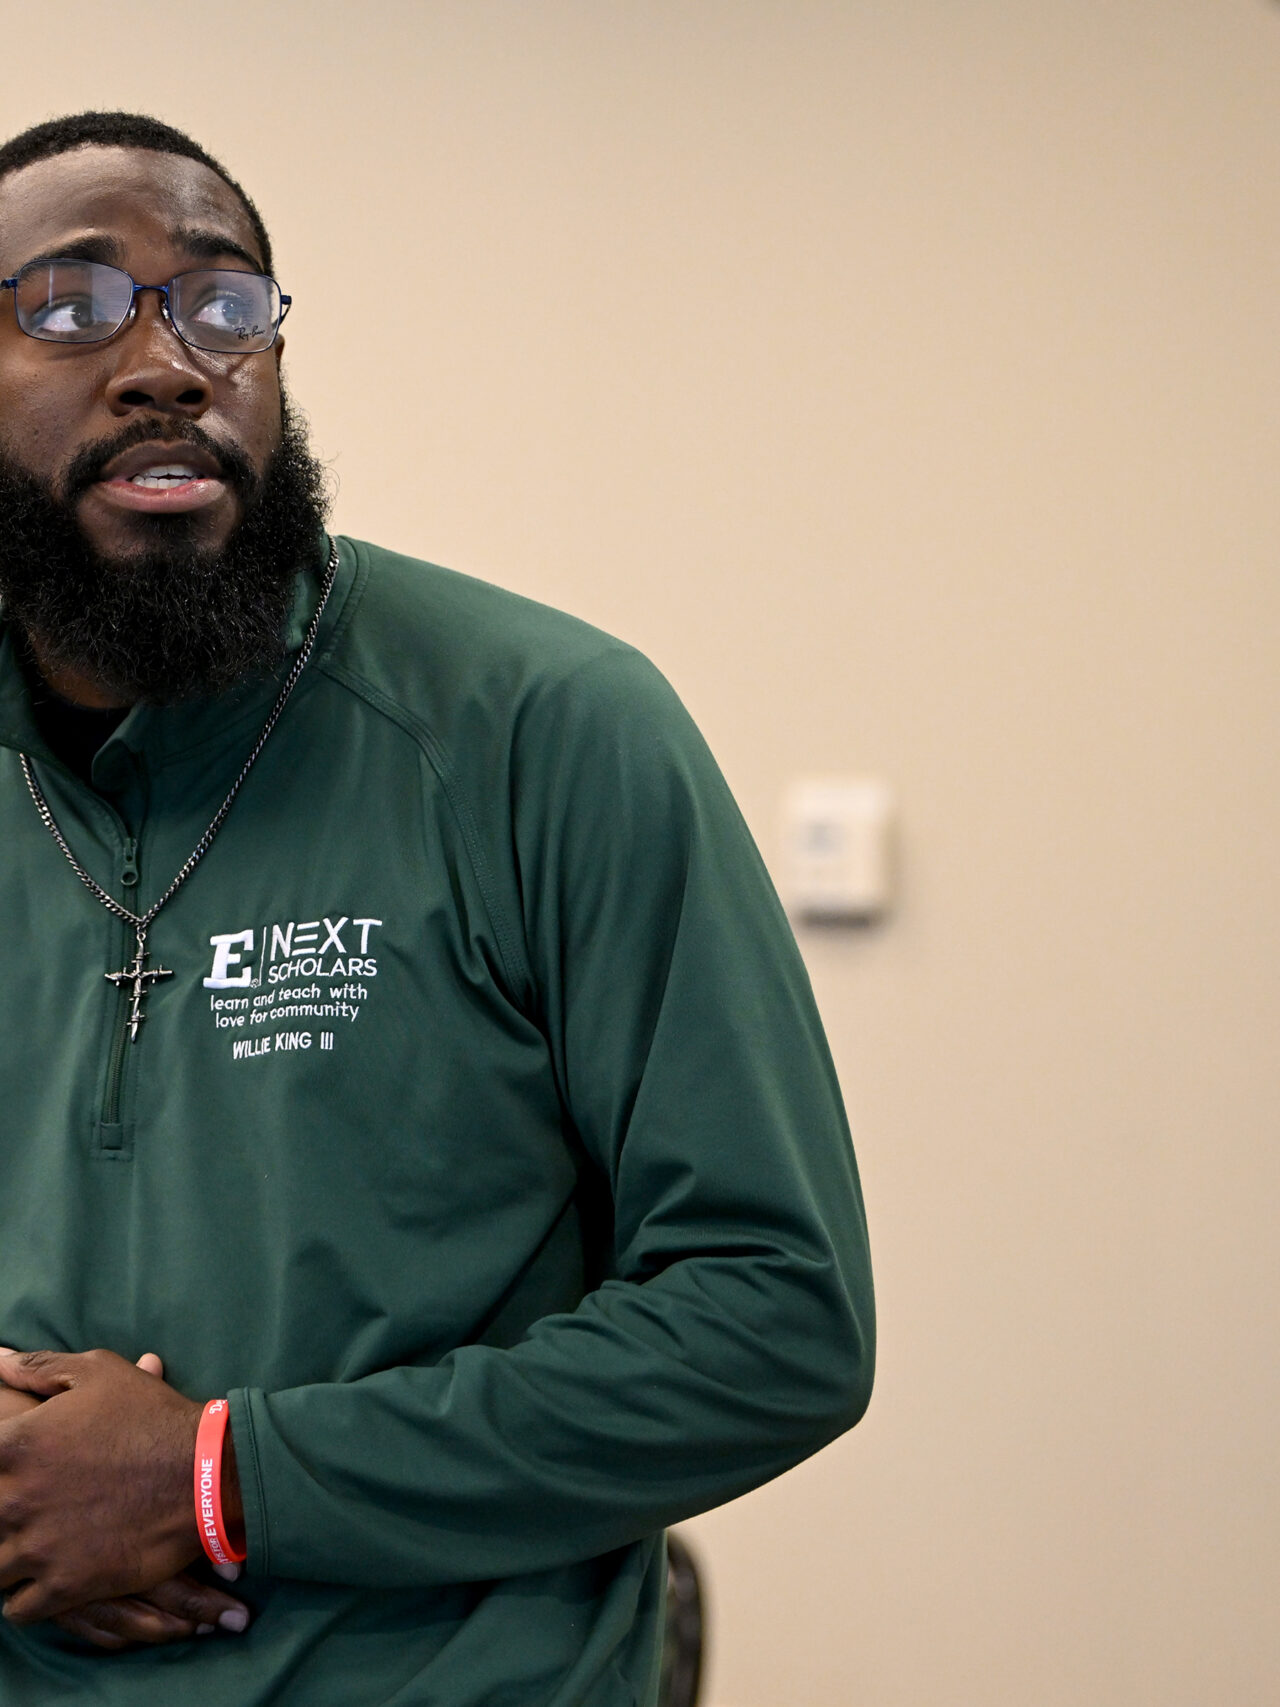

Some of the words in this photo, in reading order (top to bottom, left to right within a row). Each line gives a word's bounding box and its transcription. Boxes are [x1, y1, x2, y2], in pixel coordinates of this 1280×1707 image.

[270, 916, 383, 962] NEXT
[203, 929, 254, 989] E
[267, 957, 378, 984] SCHOLARS
[210, 995, 249, 1011] learn
[253, 990, 275, 1007] and
[278, 983, 321, 1001] teach
[330, 983, 368, 1000] with
[216, 1012, 245, 1028] love
[250, 1009, 268, 1025] for
[270, 1001, 359, 1022] community
[233, 1036, 271, 1060] WILLIE
[275, 1031, 312, 1052] KING
[320, 1031, 334, 1050] III
[200, 1458, 217, 1537] EVERYONE
